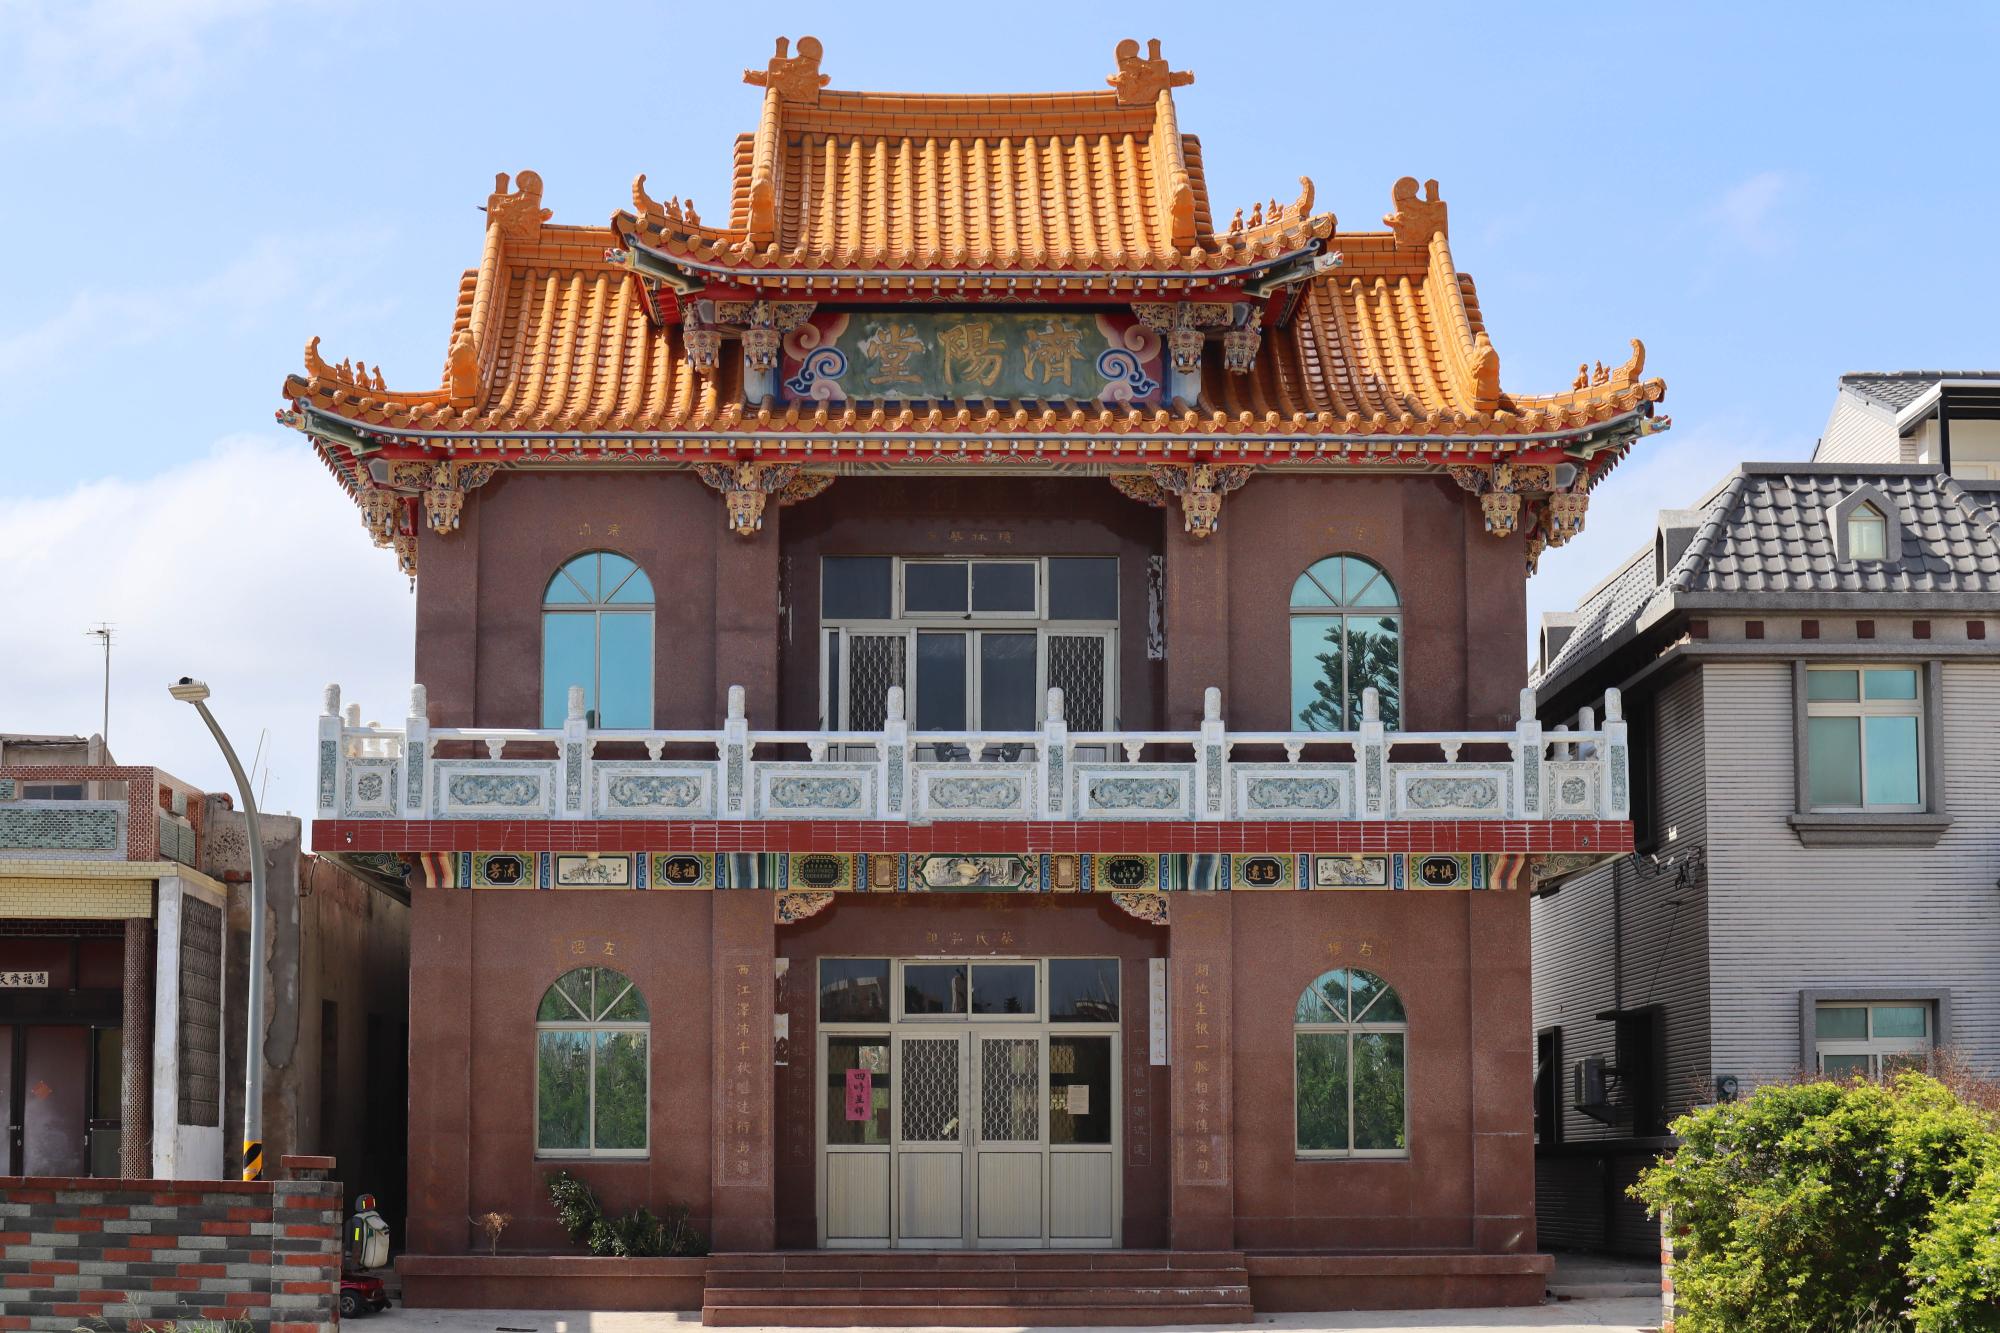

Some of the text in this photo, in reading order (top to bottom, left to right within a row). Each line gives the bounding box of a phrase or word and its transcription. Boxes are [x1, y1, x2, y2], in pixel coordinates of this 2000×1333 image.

[867, 322, 1087, 387] 濟陽堂
[489, 863, 517, 879] 流芳
[667, 863, 697, 879] 祖德
